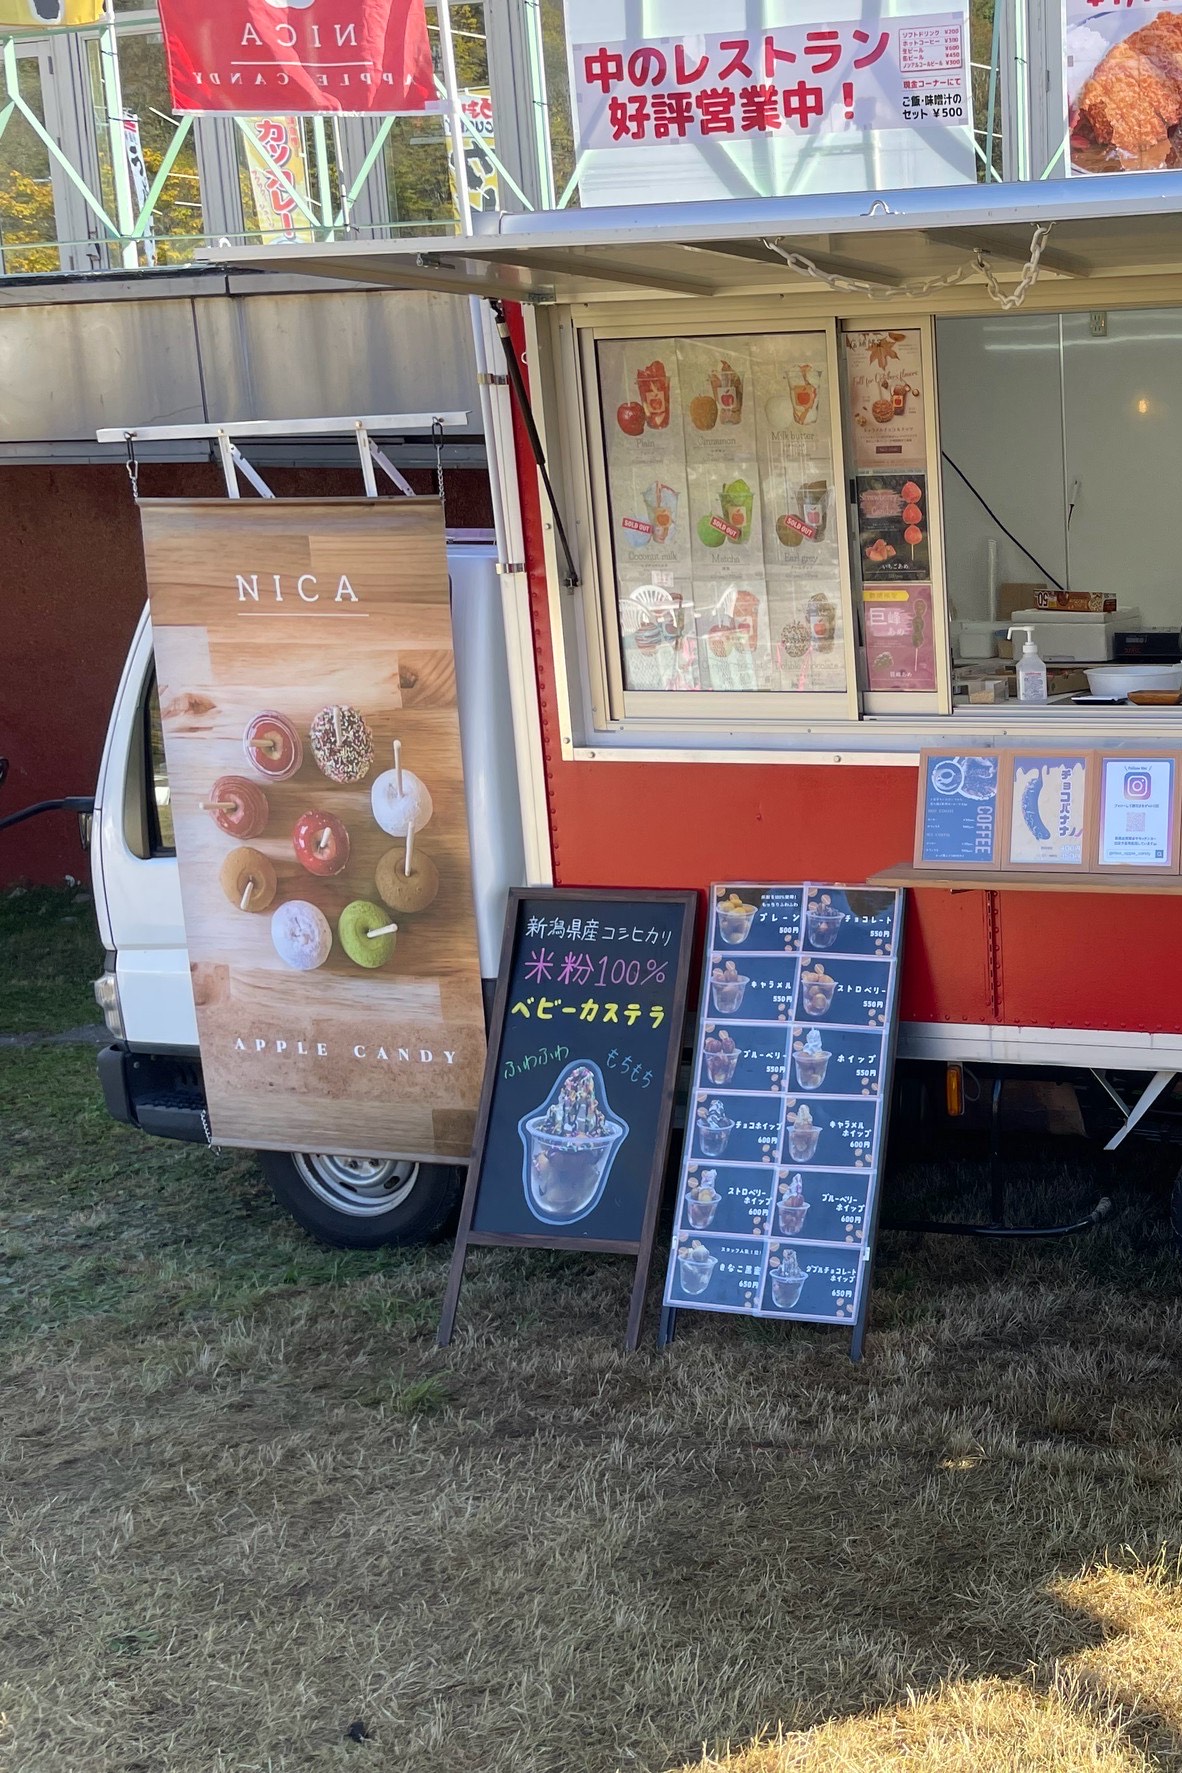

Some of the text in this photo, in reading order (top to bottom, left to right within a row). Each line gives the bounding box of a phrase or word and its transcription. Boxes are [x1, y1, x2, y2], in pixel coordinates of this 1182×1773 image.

[902, 30, 940, 38] ソフトドリンク
[584, 30, 890, 93] 中のレストラン
[903, 77, 961, 89] 現金コーナーにて
[902, 93, 962, 107] ご飯・味噌汁の
[608, 81, 855, 141] 好評営業中!
[902, 107, 963, 120] セット ¥500
[624, 519, 650, 533] SOLD OUT
[711, 518, 737, 537] SOLD OUT
[786, 517, 813, 536] SOLD OUT
[711, 554, 740, 563] Matcha
[235, 574, 360, 603] NICA
[869, 607, 900, 626] 巨峰
[1059, 768, 1072, 837] チョコバナナ
[974, 805, 993, 854] COFFEE
[759, 912, 801, 922] プレーン
[844, 914, 892, 925] チョコレート
[525, 914, 673, 947] 新潟県産コシヒカリ
[779, 926, 800, 934] 500円
[870, 930, 890, 938] 550円
[524, 947, 669, 987] 米粉100%
[750, 980, 792, 990] キャラメル
[836, 984, 887, 995] ストロベリー
[772, 995, 793, 1003] 550円
[862, 1000, 884, 1009] 550円
[511, 996, 666, 1029] ベビーカステラ
[234, 1037, 459, 1065] APPLE CANDY
[743, 1049, 787, 1060] ブルーベリー
[504, 1044, 571, 1080] ふわふわ
[836, 1053, 877, 1064] ホイップ
[606, 1047, 654, 1090] もちもち
[766, 1065, 786, 1074] 550円
[856, 1069, 877, 1077] 550円
[735, 1120, 782, 1131] チョコホイップ
[829, 1120, 865, 1130] キャラメル
[842, 1129, 872, 1138] ホイップ
[757, 1136, 778, 1145] 600円
[850, 1141, 871, 1149] 600円
[728, 1187, 767, 1197] ストロベリー
[744, 1197, 772, 1206] ホイップ
[822, 1193, 858, 1203] ブルーベリー
[748, 1208, 769, 1216] 600円
[835, 1204, 865, 1213] ホイップ
[840, 1216, 862, 1224] 600円
[806, 1265, 857, 1276] ダブルチョコレート
[738, 1280, 760, 1289] 650円
[830, 1274, 856, 1284] ホイップ
[831, 1289, 852, 1298] 650円
